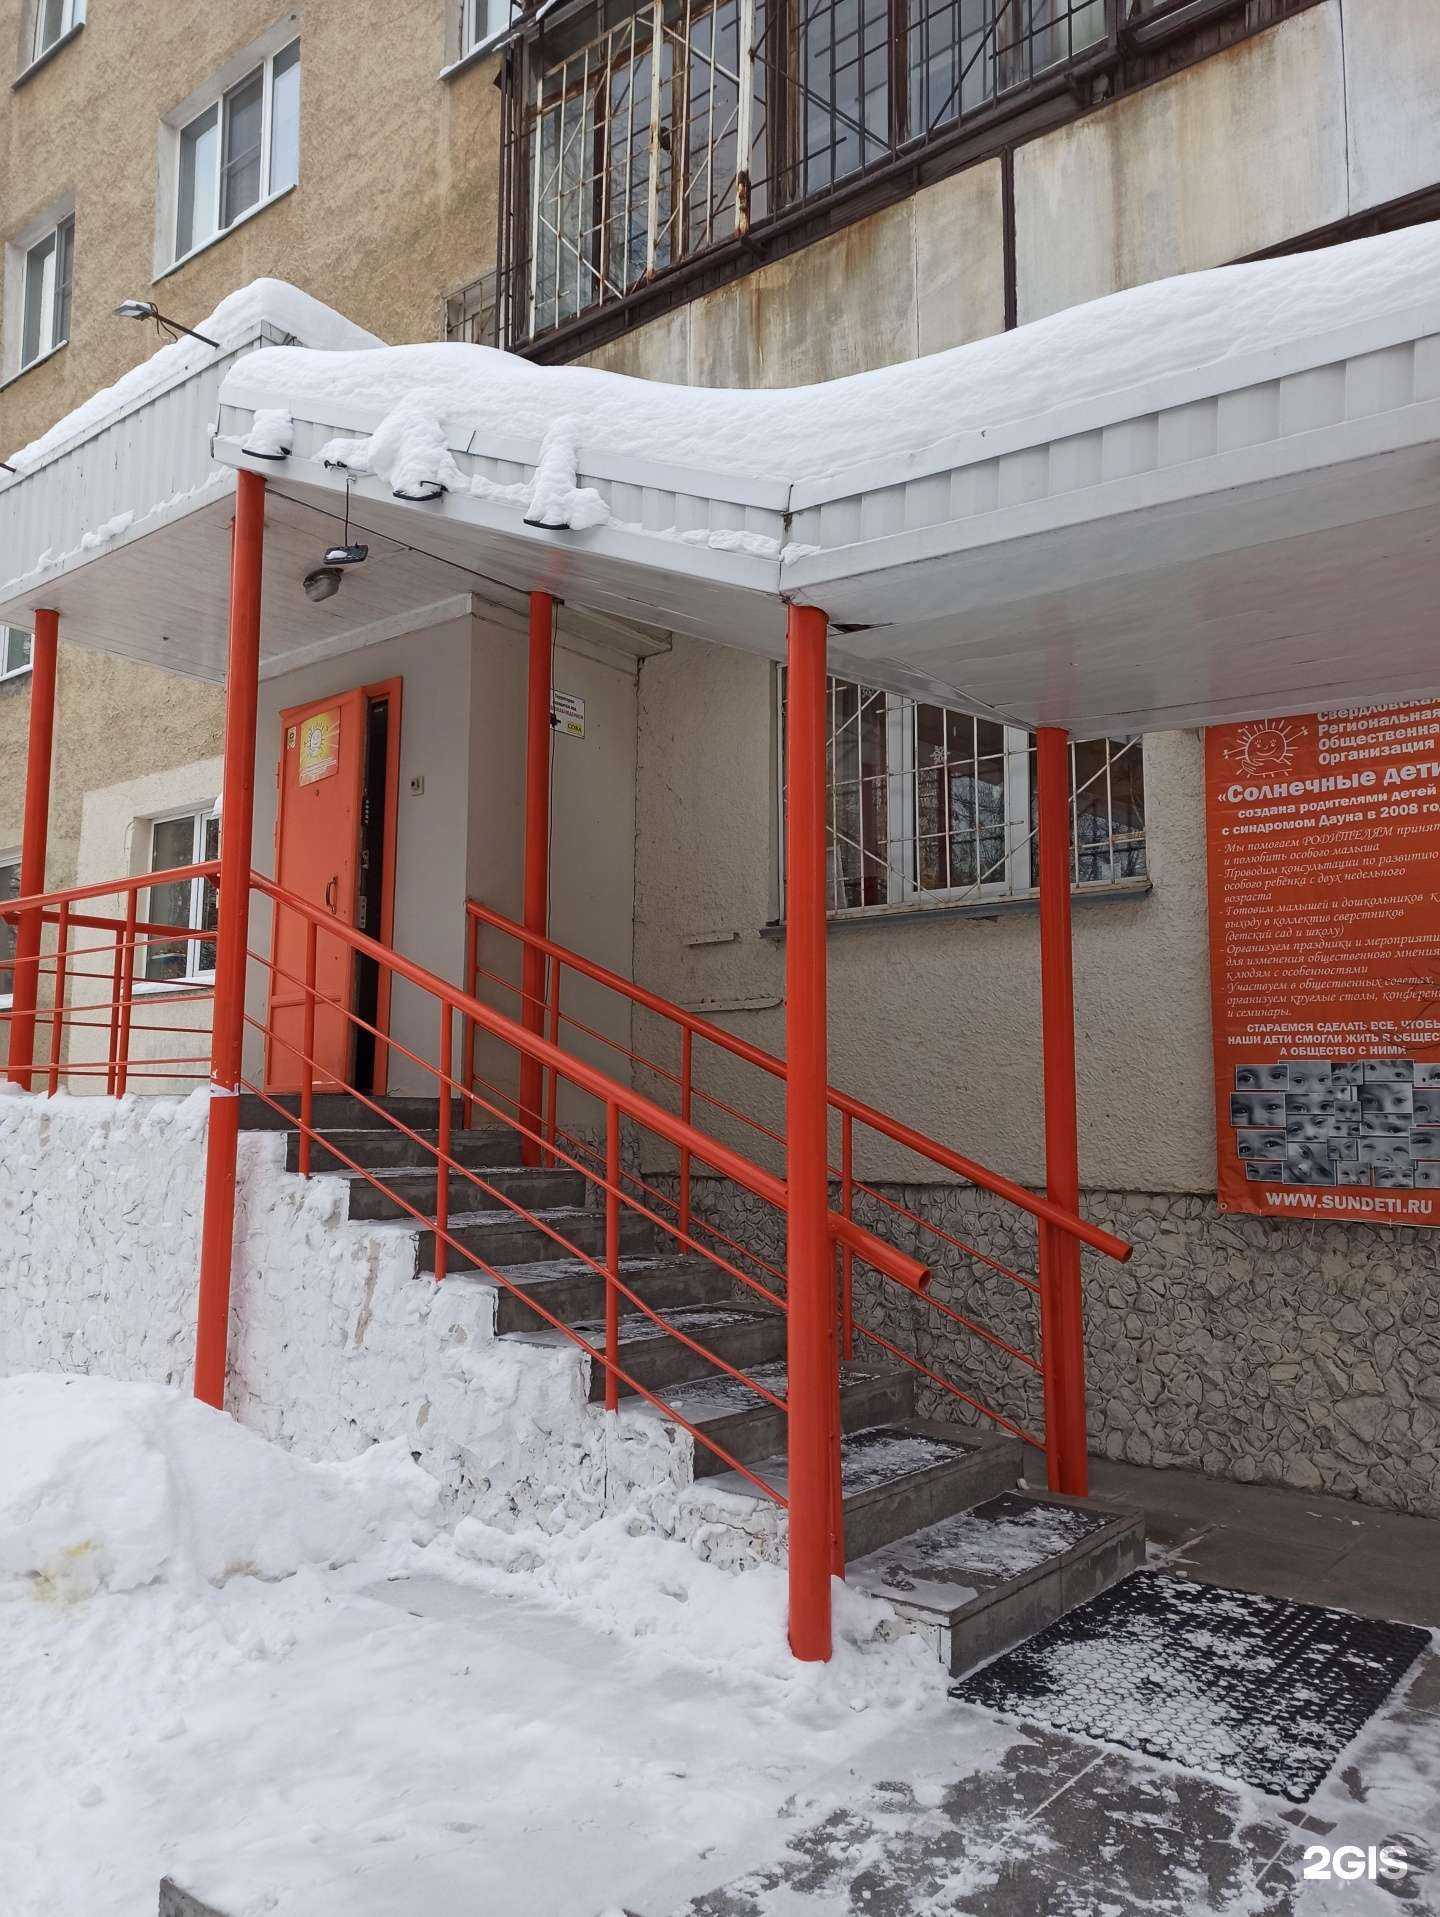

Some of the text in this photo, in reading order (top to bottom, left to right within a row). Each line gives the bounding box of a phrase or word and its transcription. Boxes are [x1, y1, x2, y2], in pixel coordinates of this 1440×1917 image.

[1318, 739, 1434, 765] Организация
[1218, 771, 1376, 803] «Солнечные
[1238, 784, 1436, 818] создана родителями детей
[1222, 802, 1440, 835] с синдромом Дауна в 2008 го
[1224, 843, 1244, 853] Мы
[1247, 839, 1299, 851] помогаем
[1303, 826, 1393, 845] РОДИТЕЛЯМ
[1290, 848, 1329, 860] особого
[1332, 843, 1380, 855] малыша
[1224, 851, 1439, 880] Проводим консультации по развитию
[1224, 878, 1262, 891] особого
[1317, 873, 1343, 885] двух
[1344, 868, 1406, 881] недельного
[1224, 892, 1272, 905] возраста
[1226, 905, 1273, 916] Готовим
[1276, 900, 1328, 913] малышей
[1342, 893, 1424, 908] дошкольников
[1225, 908, 1404, 929] выходу в коллектив сверстников
[1225, 923, 1345, 943] (детский сад и школу)
[1226, 942, 1290, 957] Организуем
[1293, 938, 1352, 953] праздники
[1225, 956, 1244, 967] для
[1247, 955, 1304, 966] изменения
[1307, 950, 1392, 964] общественного
[1282, 965, 1368, 977] особенностями
[1227, 981, 1287, 994] Участвуем
[1299, 978, 1383, 991] общественных
[1226, 995, 1287, 1008] организуем
[1290, 993, 1337, 1005] круглые
[1247, 1022, 1313, 1032] СТАРАЕМСЯ
[1317, 1022, 1367, 1033] СДЕЛАТЬ
[1371, 1021, 1397, 1032] ВСЕ,
[1228, 1036, 1261, 1044] НАШИ
[1263, 1035, 1293, 1046] ДЕТИ
[1296, 1034, 1342, 1044] СМОГЛИ
[1346, 1033, 1379, 1043] ЖИТЬ
[1280, 1047, 1288, 1055] А
[1291, 1046, 1356, 1057] ОБЩЕСТВО
[1359, 1046, 1366, 1055] С
[1266, 1192, 1432, 1214] WWW.SUNDETI.RU
